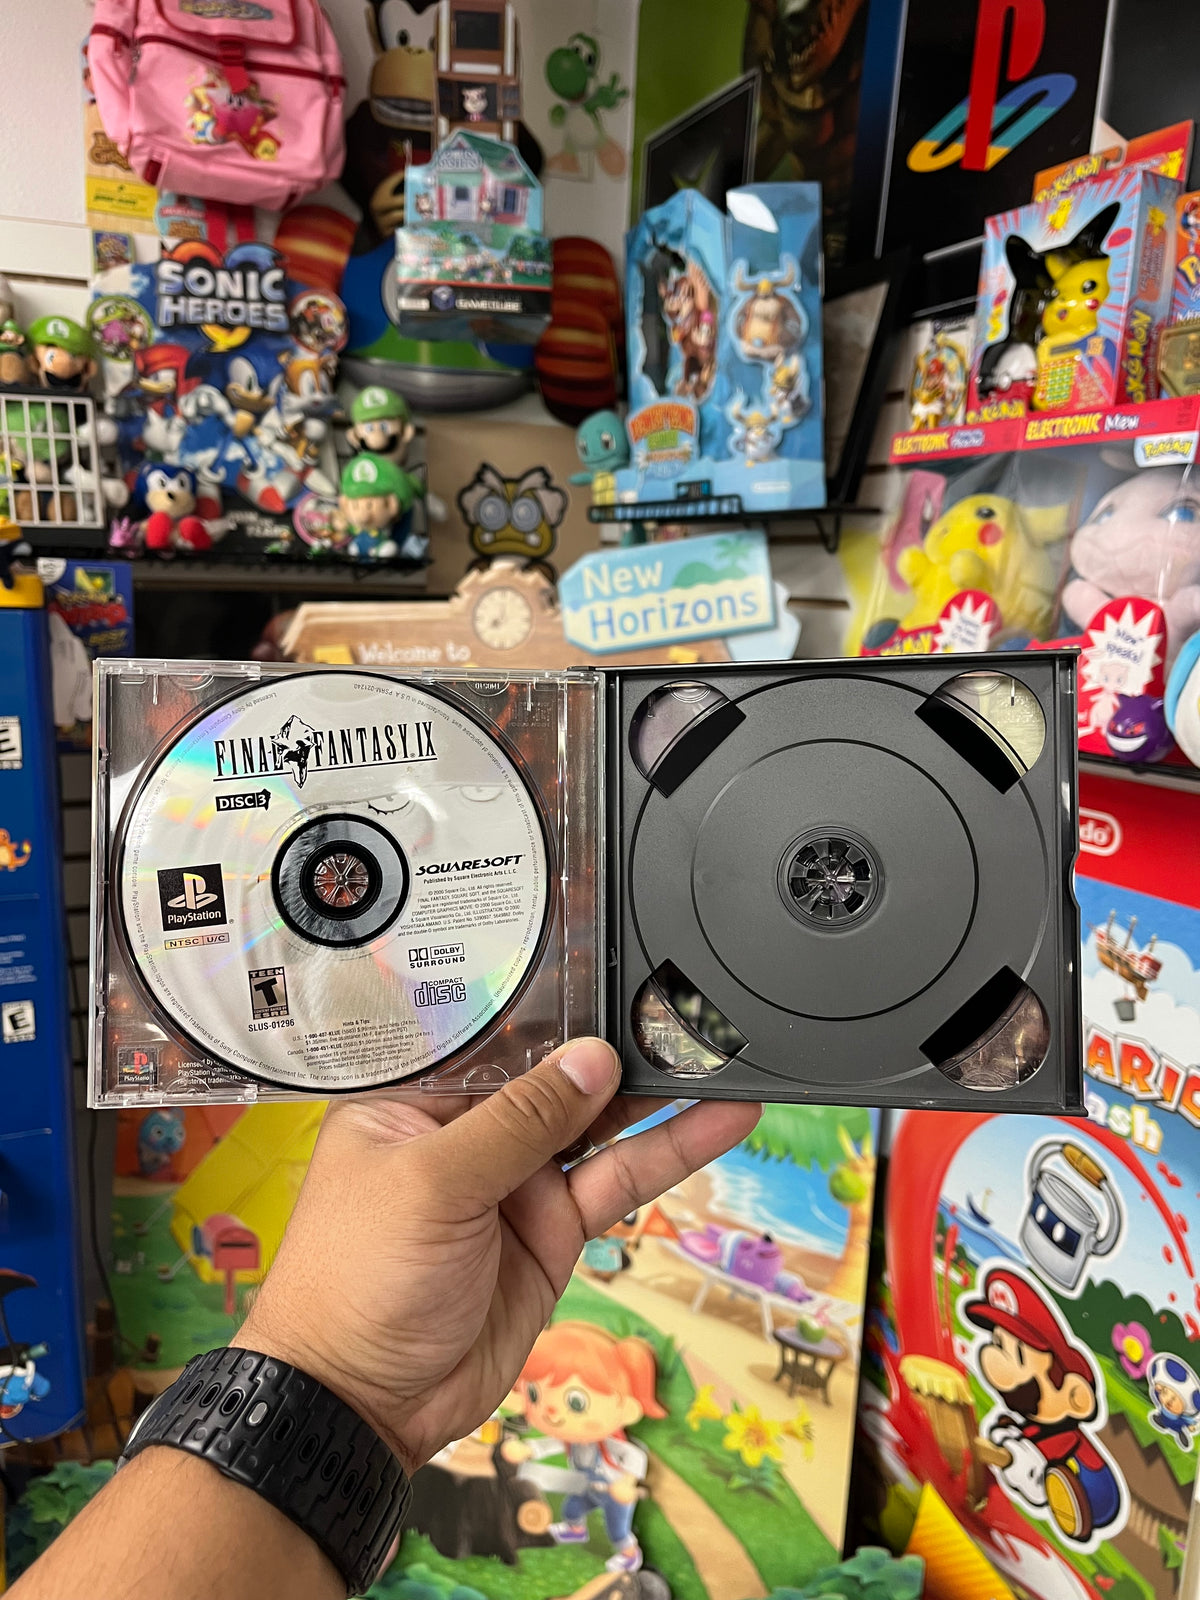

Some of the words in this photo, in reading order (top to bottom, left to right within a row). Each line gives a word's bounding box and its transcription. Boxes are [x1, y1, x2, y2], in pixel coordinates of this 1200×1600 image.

[157, 260, 287, 301] SONIC
[158, 296, 290, 332] HEROES
[1025, 412, 1103, 442] ELECTRONIC
[1104, 413, 1140, 433] Mew
[582, 560, 664, 599] New
[588, 591, 758, 641] Horizons
[357, 640, 442, 664] Welcome
[446, 639, 472, 663] to
[214, 735, 284, 777] FINAL
[312, 722, 410, 768] FANTASY
[415, 721, 437, 757] IX
[218, 795, 255, 810] DISC
[256, 793, 268, 807] 3
[520, 808, 533, 834] broadcast
[415, 854, 523, 876] SQUARESOFT
[530, 841, 540, 873] performance
[423, 876, 446, 884] Published
[453, 873, 469, 881] Square
[131, 890, 141, 921] PlayStation
[167, 909, 222, 925] PlayStation
[169, 937, 200, 948] NTSC
[205, 934, 227, 944] U/C
[433, 946, 461, 956] DOLBY
[140, 943, 158, 973] PlayStation
[409, 955, 466, 969] SURROUND
[250, 967, 284, 978] TEEN
[428, 976, 464, 987] COMPACT
[254, 977, 278, 1007] T
[413, 981, 467, 1008] disc
[168, 995, 190, 1019] registered
[8, 1007, 31, 1031] E
[188, 1017, 214, 1040] trademarks
[248, 1019, 295, 1033] SLUS-01296
[452, 1022, 472, 1040] Software
[218, 1041, 233, 1054] Sony
[436, 1038, 453, 1051] Digital
[231, 1049, 258, 1067] Computer
[258, 1061, 296, 1077] Entertainment
[177, 1068, 210, 1078] PlayStation
[365, 1066, 393, 1077] trademark
